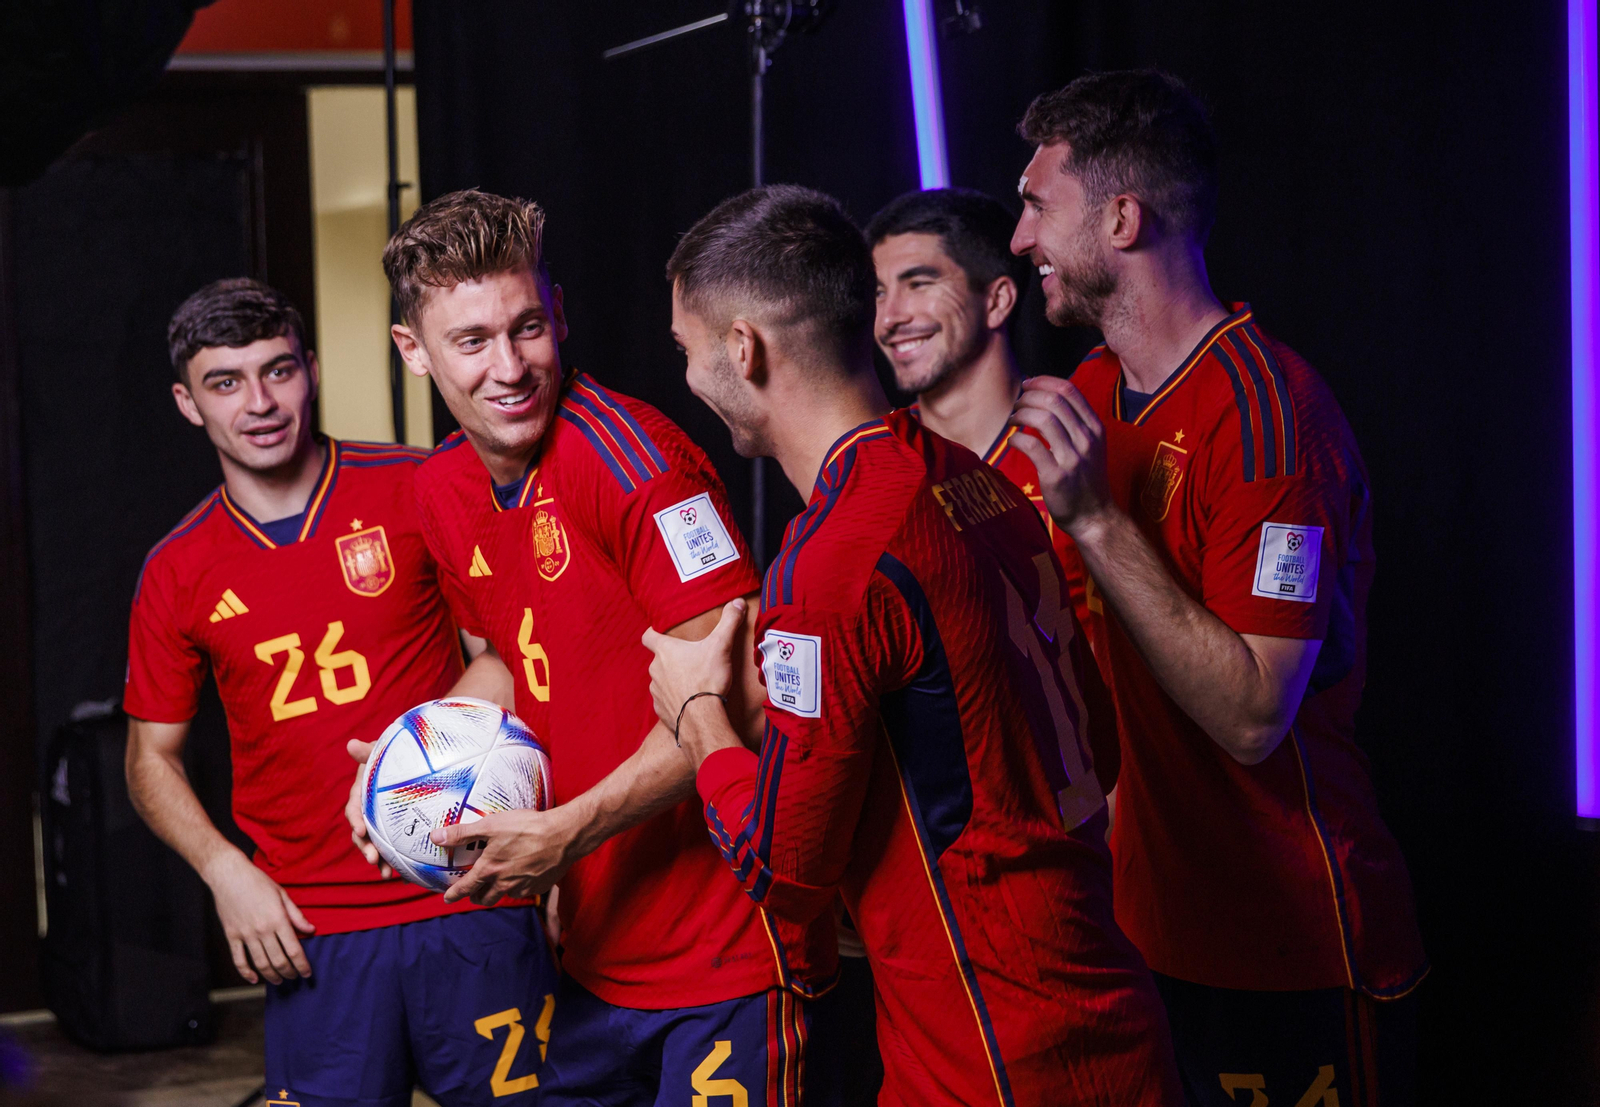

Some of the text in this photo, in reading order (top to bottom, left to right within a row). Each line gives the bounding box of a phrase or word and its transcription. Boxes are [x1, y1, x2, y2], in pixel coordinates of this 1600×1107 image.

[931, 466, 1018, 532] FERRAN
[683, 524, 710, 540] FOOTBALL
[686, 531, 714, 550] UNITES
[689, 540, 720, 559] the World
[1277, 553, 1305, 563] FOOTBALL
[1276, 561, 1305, 574] UNITES
[1273, 572, 1305, 584] the World
[517, 607, 549, 702] 6
[254, 620, 372, 722] 26
[773, 661, 800, 675] FOOTBALL
[774, 670, 801, 686] UNITES
[774, 681, 802, 697] the World
[782, 694, 795, 704] FIFA
